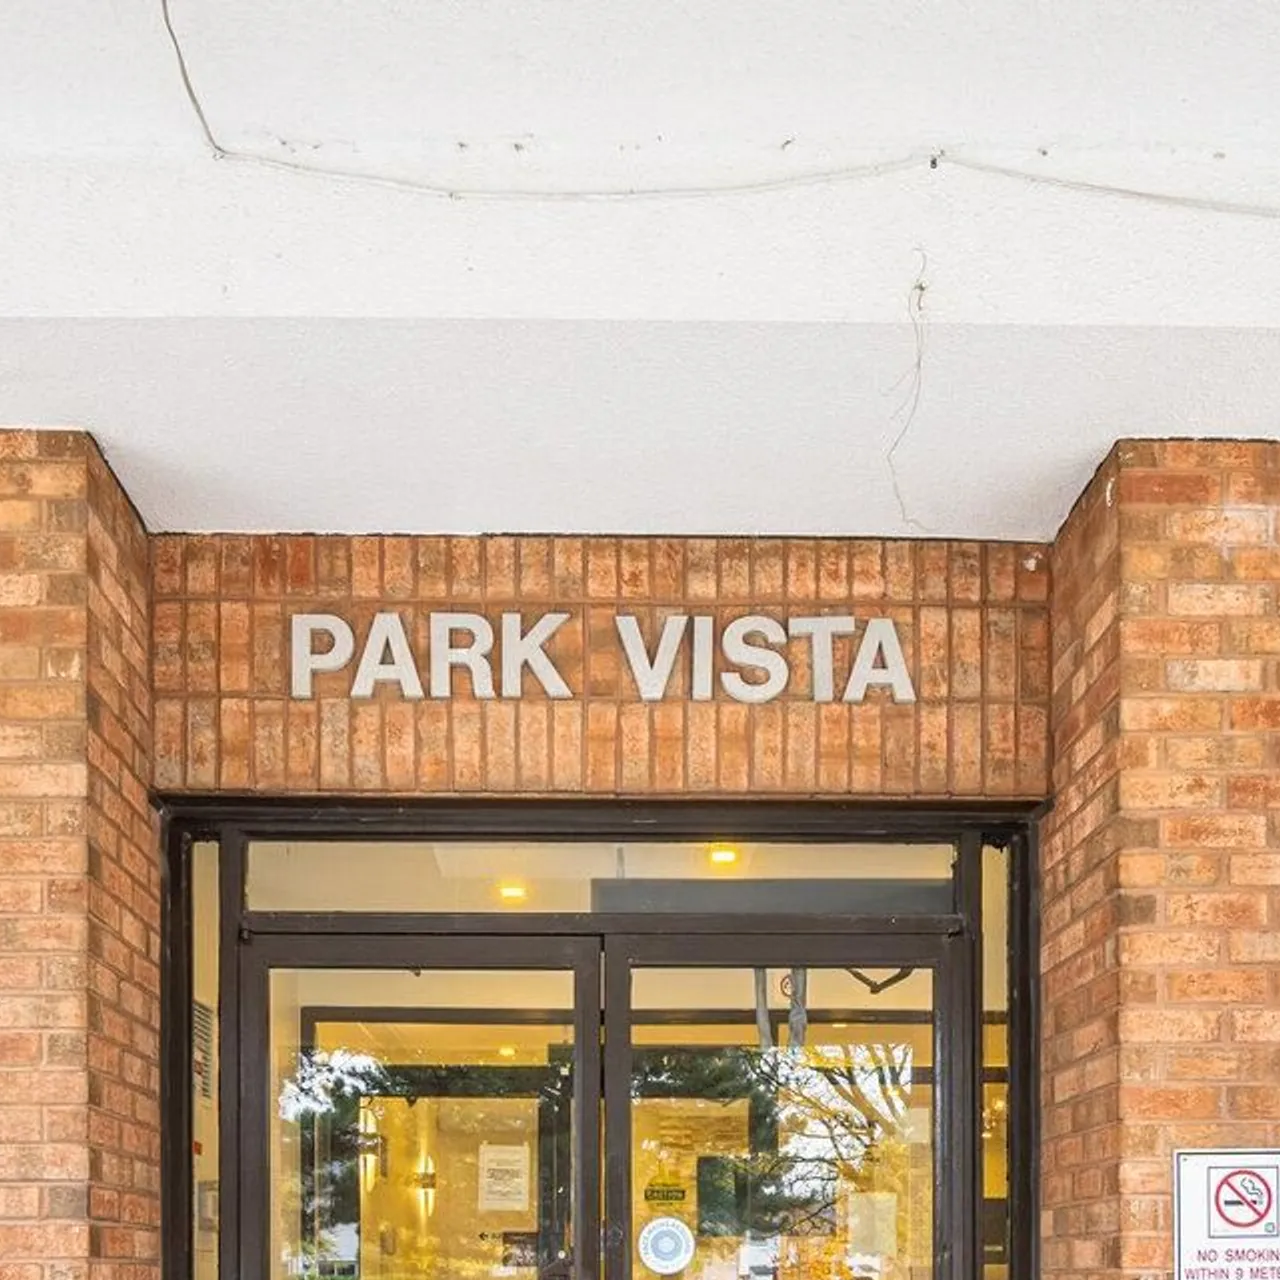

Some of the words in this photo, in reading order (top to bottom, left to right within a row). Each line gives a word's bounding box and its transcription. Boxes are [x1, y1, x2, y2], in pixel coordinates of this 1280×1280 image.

[290, 611, 575, 701] PARK
[615, 613, 917, 705] VISTA
[1196, 1249, 1218, 1263] NO
[1184, 1267, 1230, 1280] WITHIN
[1235, 1267, 1244, 1280] 9
